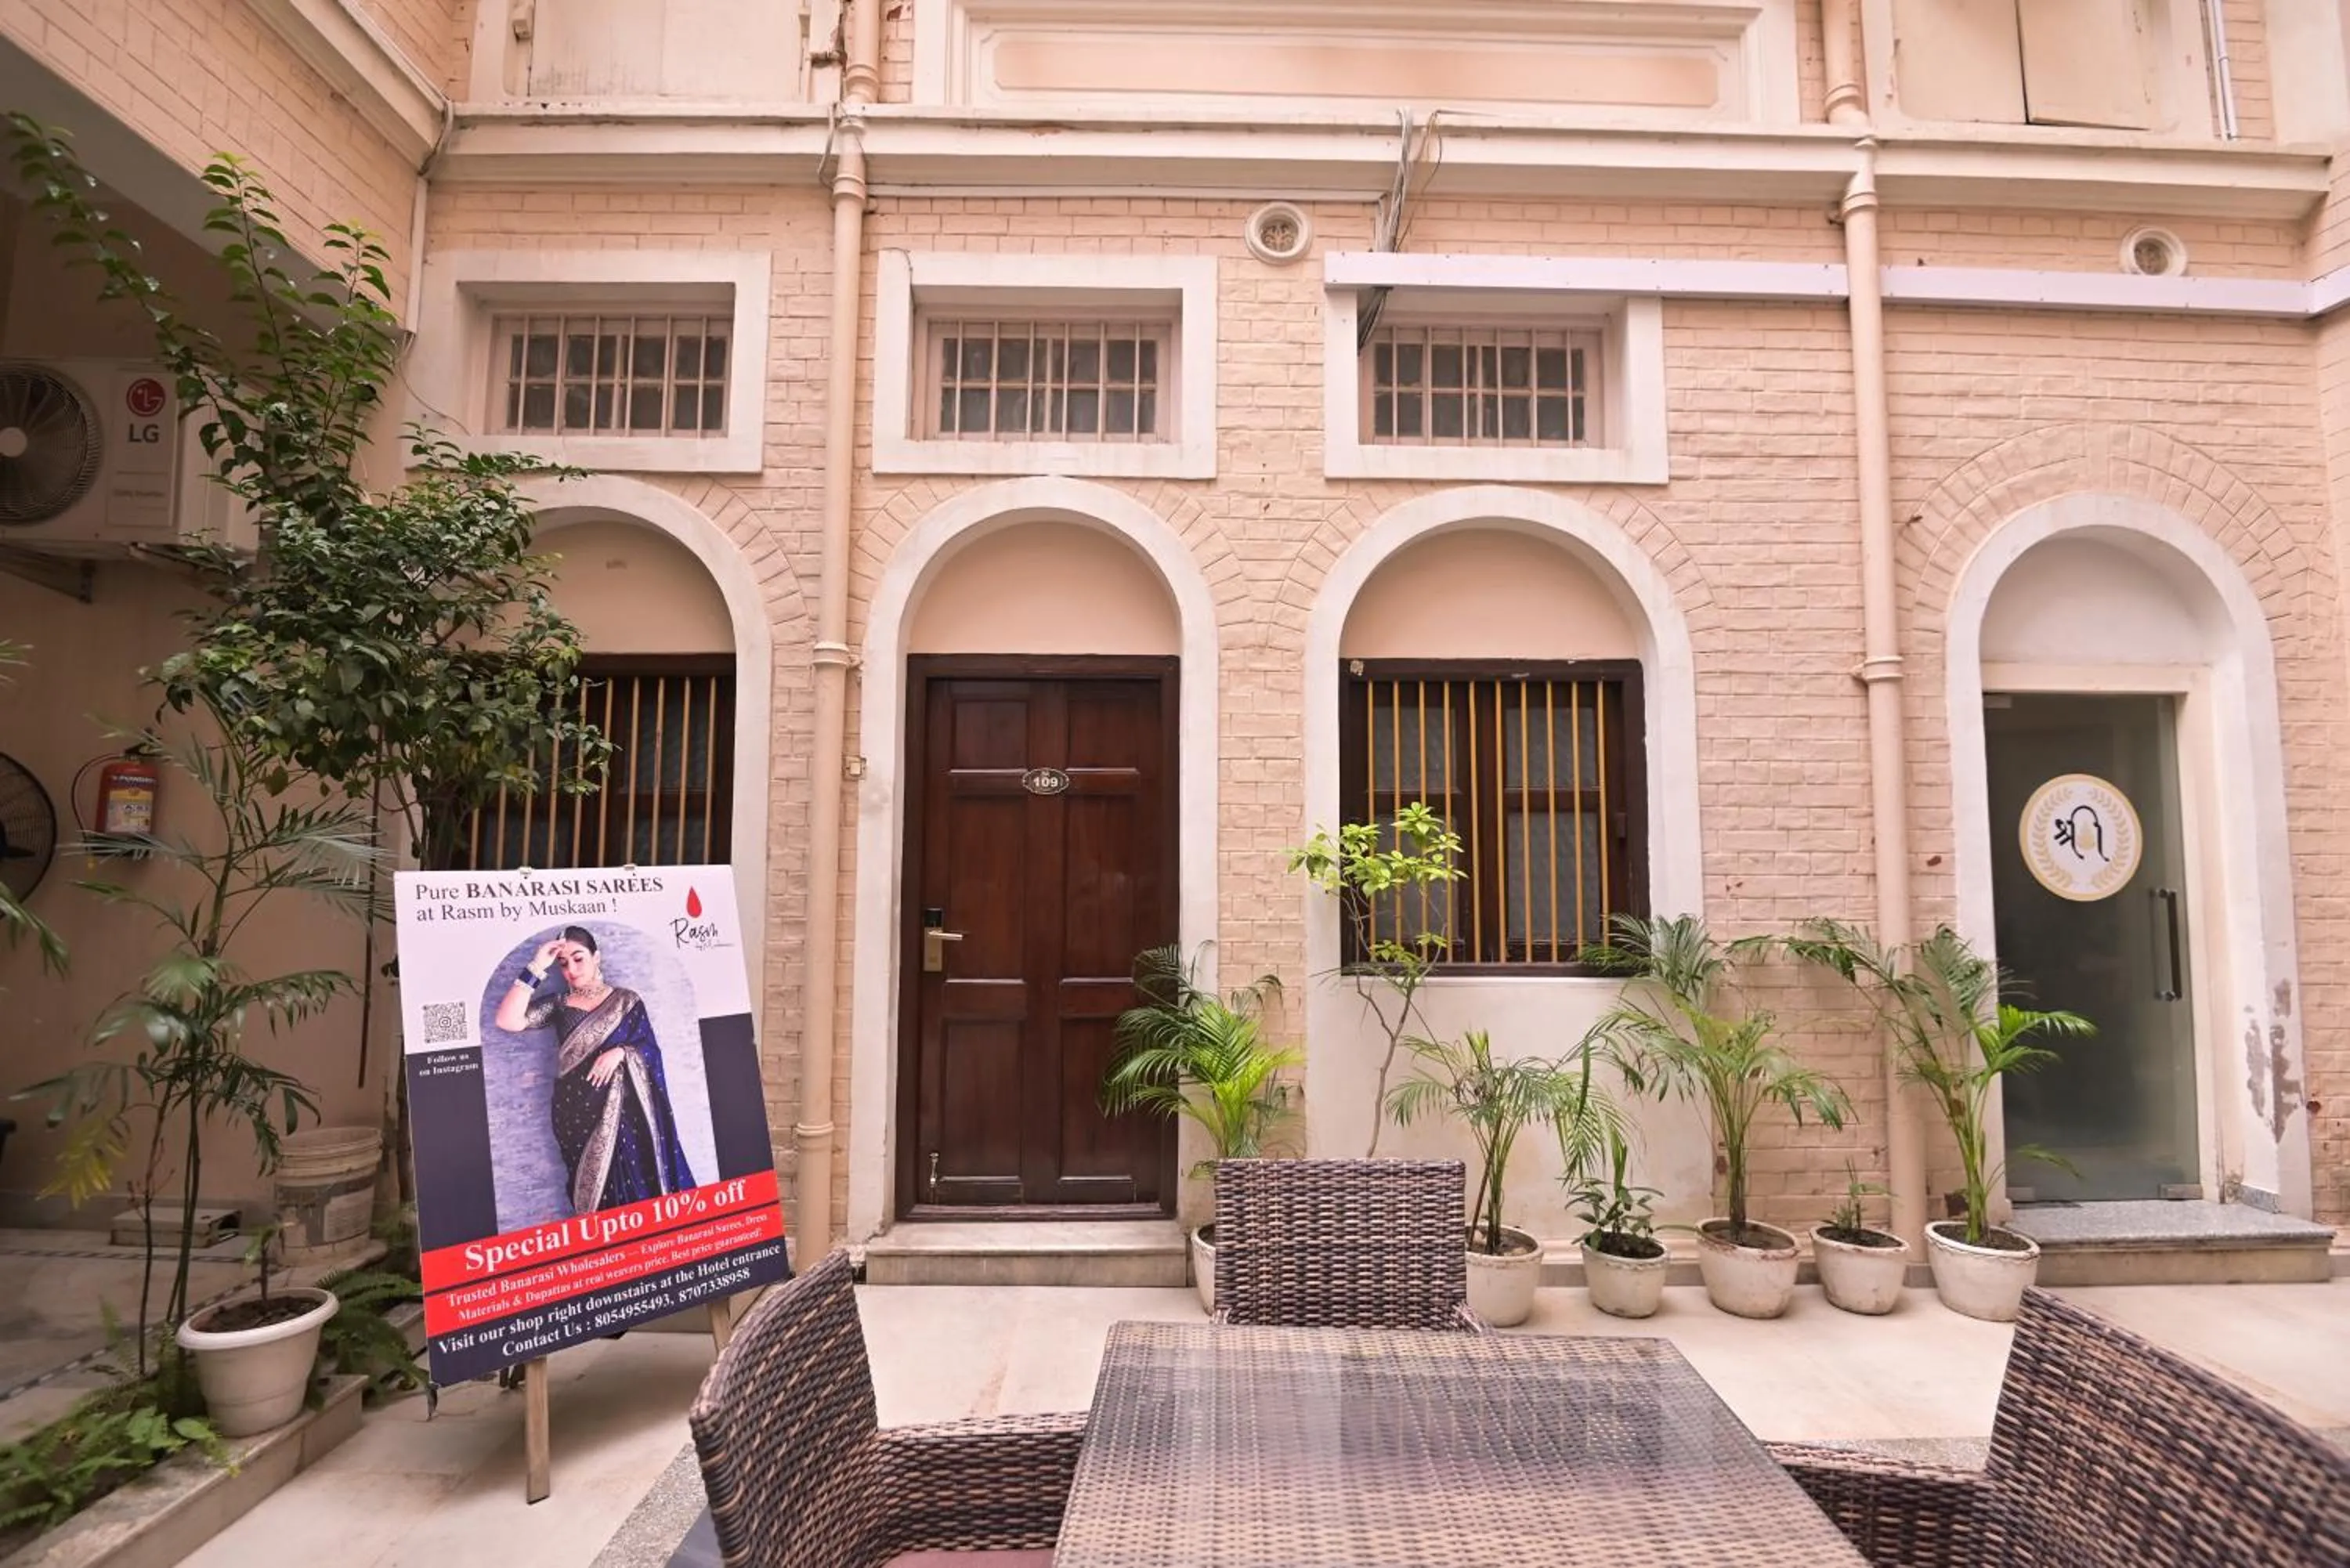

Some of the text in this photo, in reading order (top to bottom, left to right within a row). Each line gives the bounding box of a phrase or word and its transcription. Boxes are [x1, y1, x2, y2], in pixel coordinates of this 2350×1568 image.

[128, 423, 160, 443] LG
[1033, 776, 1058, 787] 109
[415, 877, 663, 900] Pure BANARASI SAREES
[417, 905, 433, 921] at
[441, 903, 494, 920] Rasm
[501, 901, 522, 922] by
[529, 899, 606, 916] Muskaan
[427, 1055, 456, 1064] Follow
[433, 1063, 479, 1075] Instagram
[465, 1180, 747, 1273] Special Upto 10% off
[501, 1271, 555, 1292] Banarasi
[557, 1249, 626, 1276] Wholesalers
[640, 1238, 674, 1255] Explore
[677, 1226, 714, 1245] Banarasi
[458, 1299, 510, 1321] Materials
[513, 1295, 522, 1307] &
[526, 1284, 571, 1304] Dupattas
[573, 1277, 583, 1288] at
[585, 1274, 604, 1286] real
[605, 1265, 643, 1279] weavers
[671, 1248, 691, 1260] Best
[692, 1244, 713, 1258] price
[438, 1245, 781, 1354] Visit our shop right downstairs at the Hotel entrance
[502, 1328, 559, 1357] Contact
[564, 1322, 582, 1337] Us
[678, 1267, 751, 1303] 8707338958
